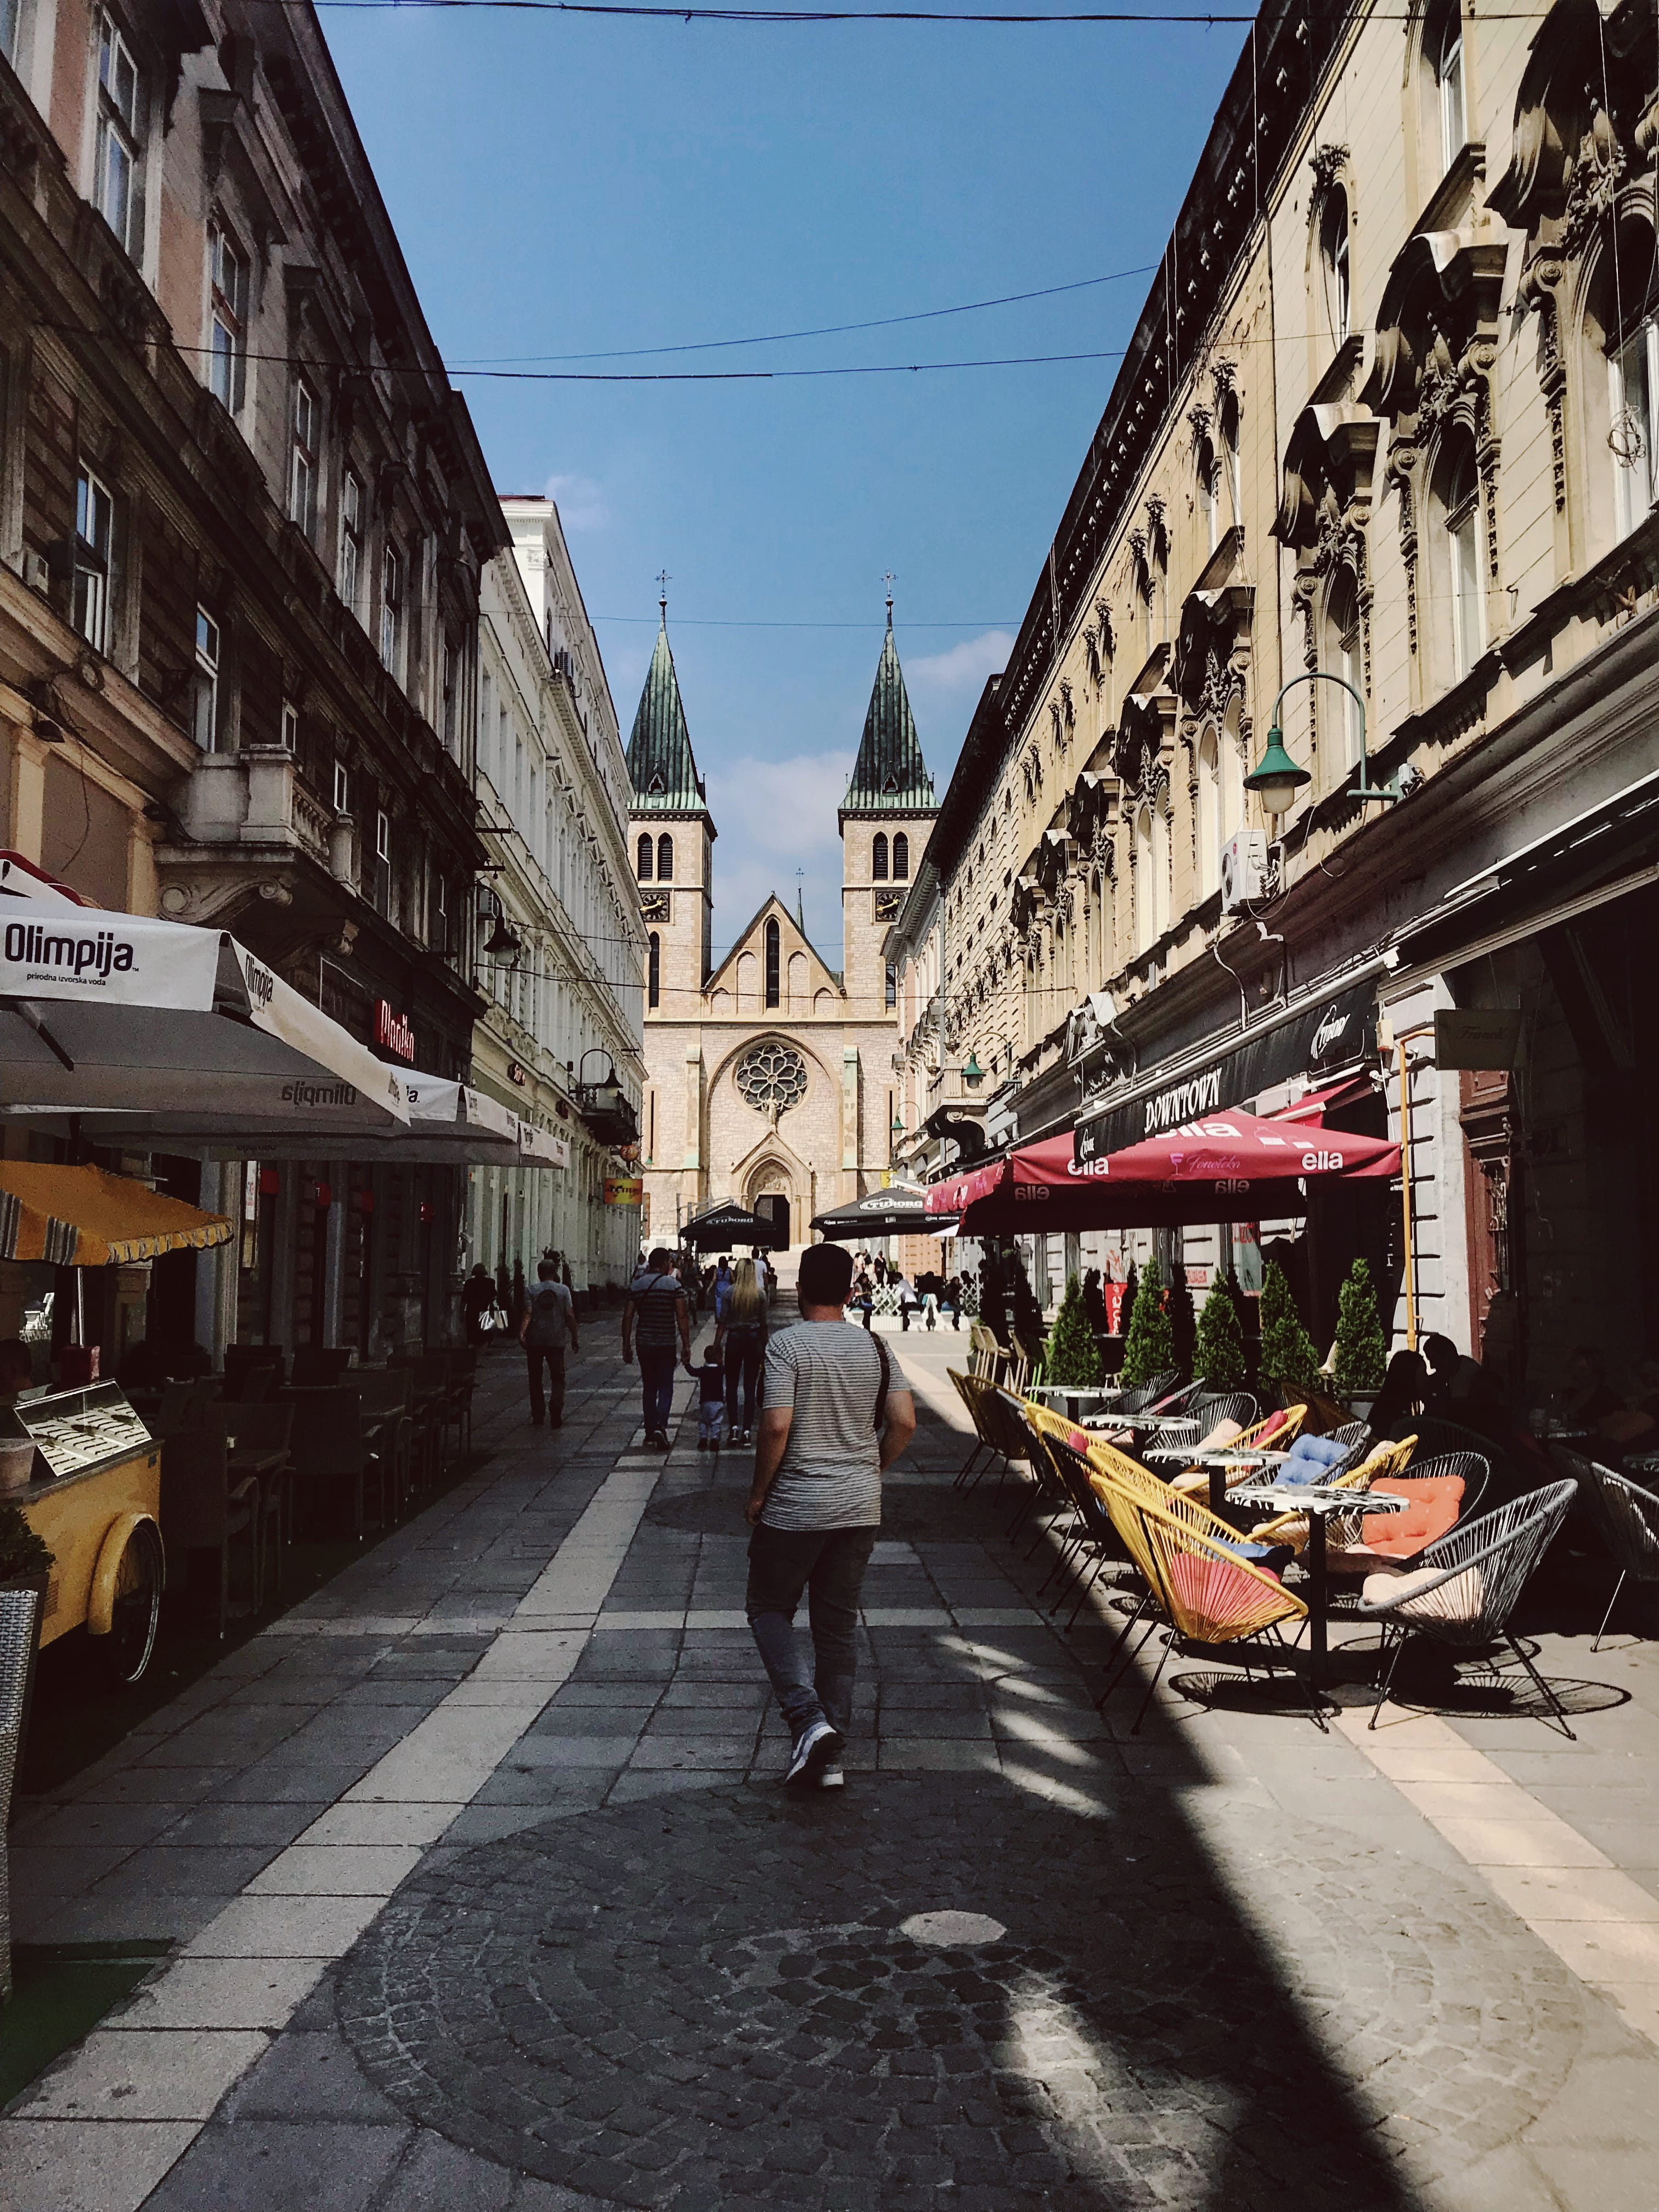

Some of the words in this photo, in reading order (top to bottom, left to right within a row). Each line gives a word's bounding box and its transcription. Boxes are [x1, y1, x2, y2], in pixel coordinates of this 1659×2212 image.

[5, 923, 133, 977] Olimpija
[27, 973, 57, 981] prirodna
[58, 975, 87, 984] izvorska
[1144, 1066, 1222, 1134] DOWNTOWN
[1302, 1150, 1344, 1171] ella
[865, 1199, 923, 1207] TUBORG
